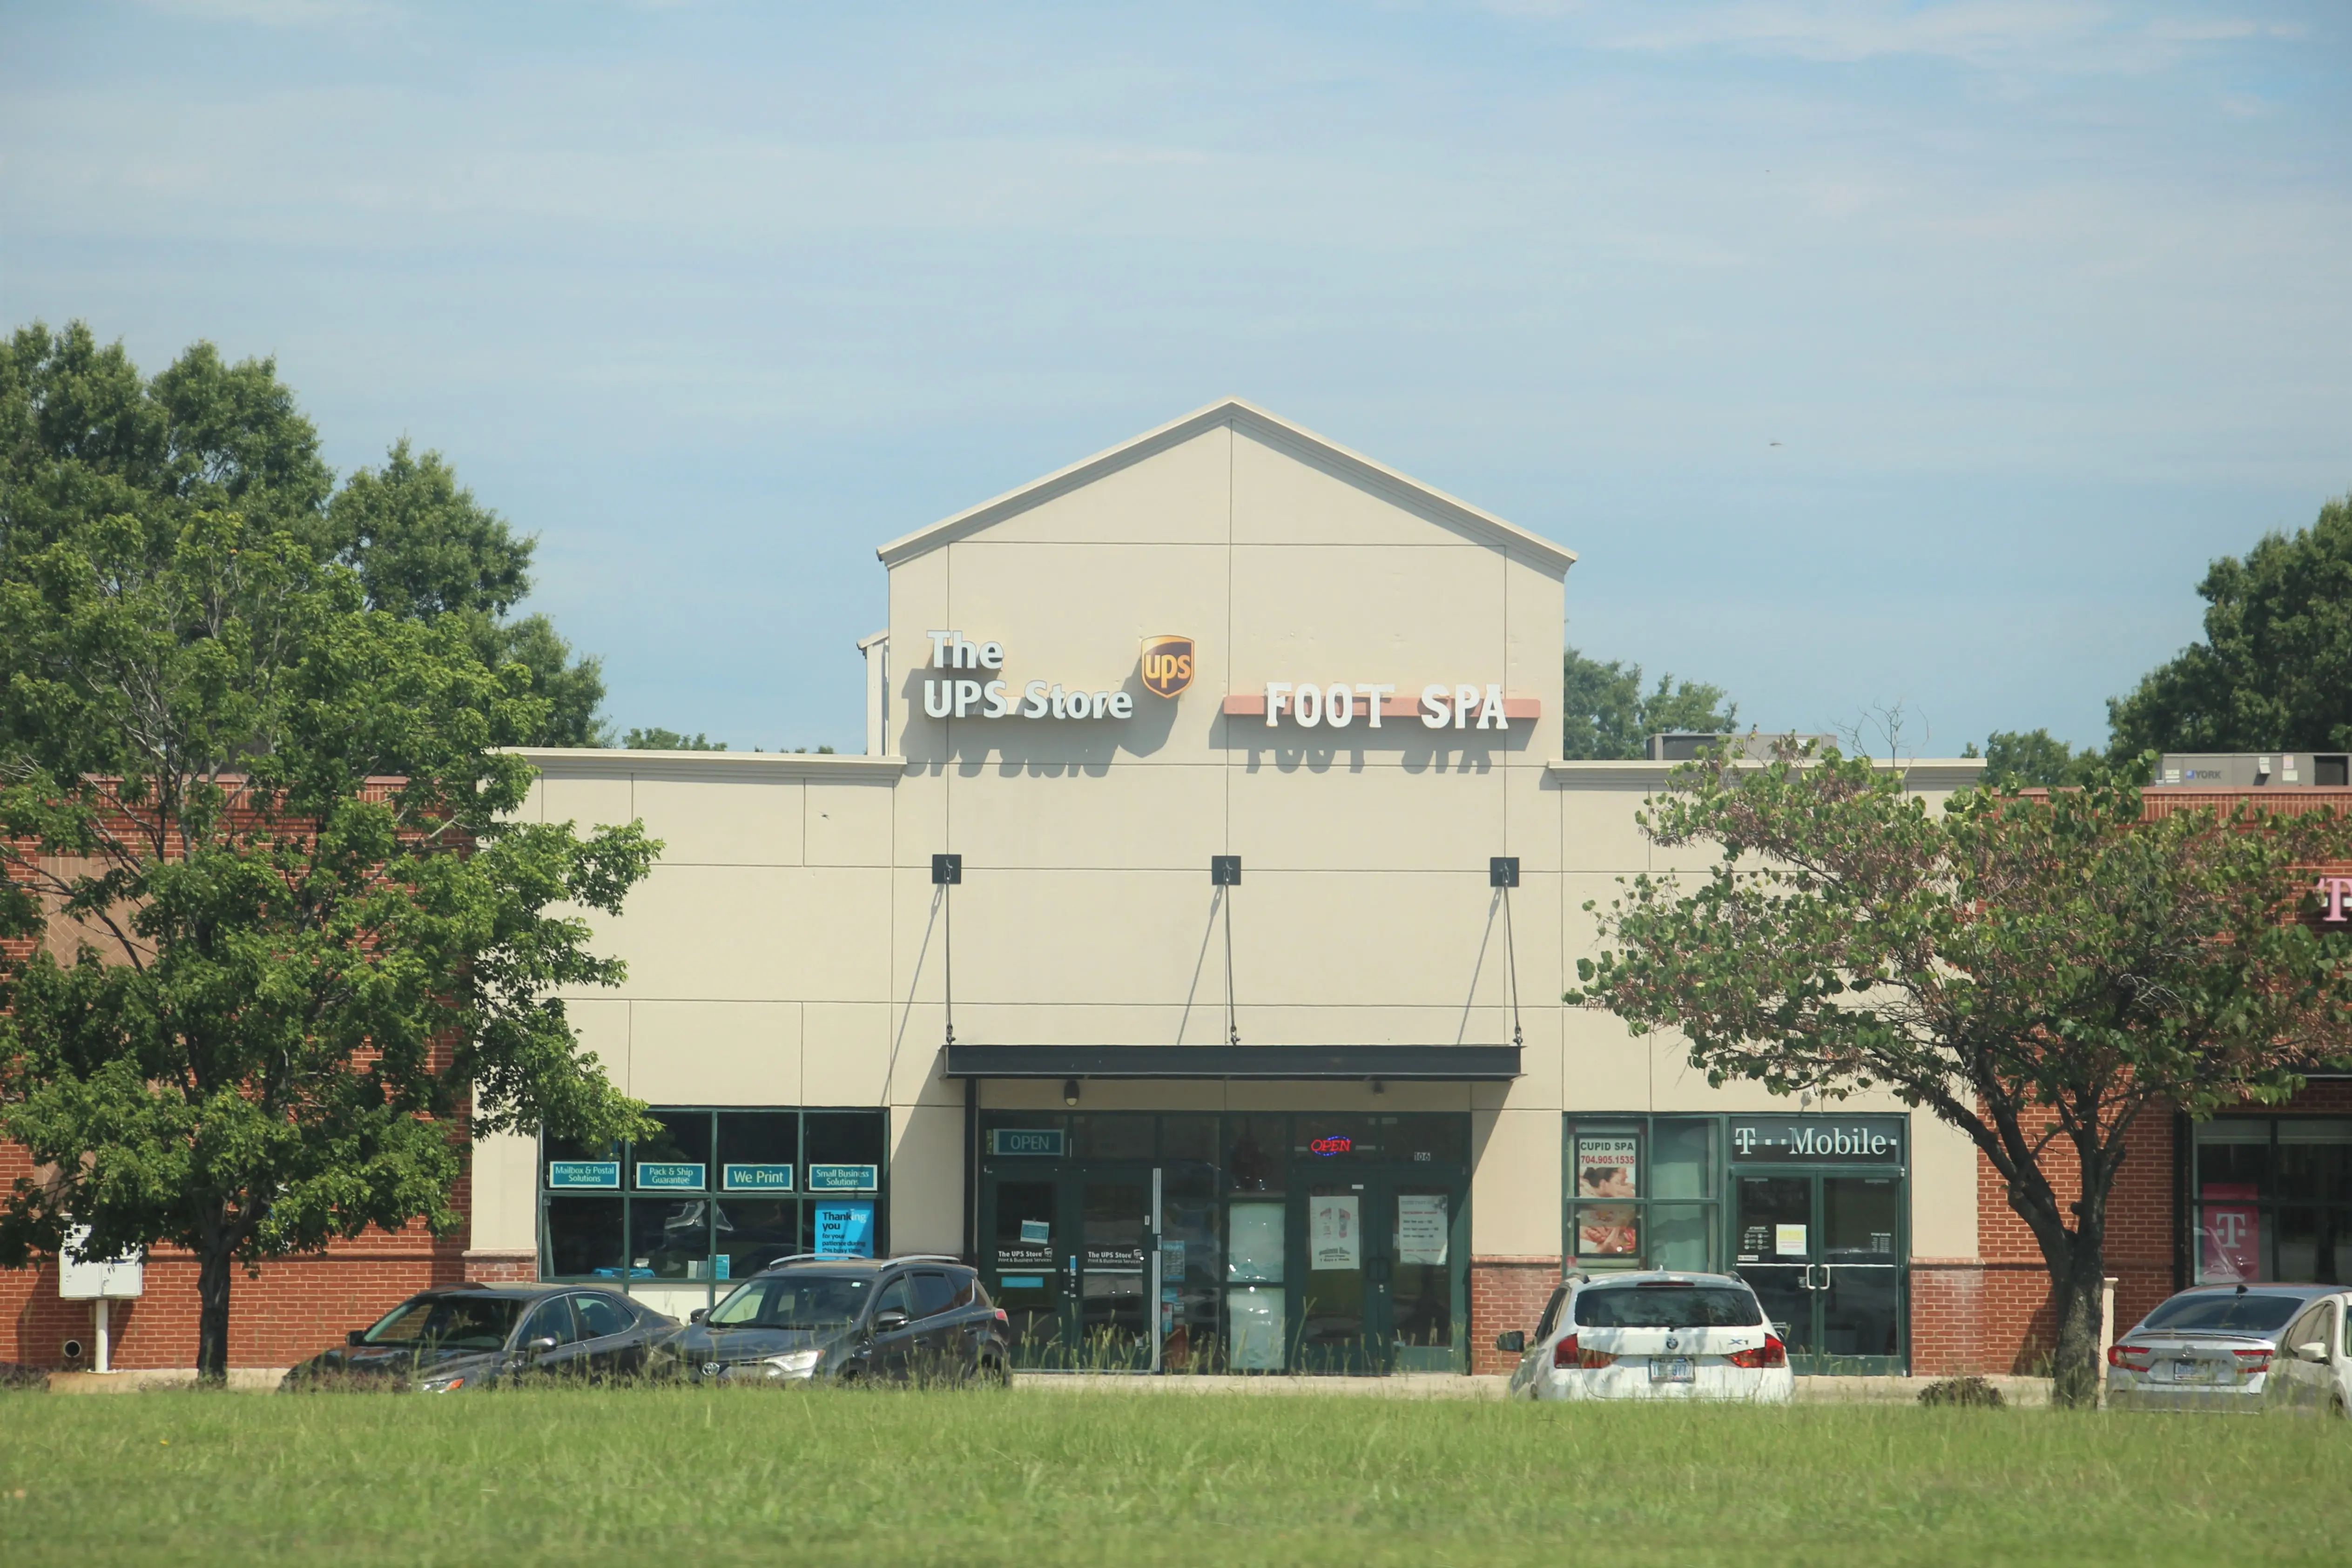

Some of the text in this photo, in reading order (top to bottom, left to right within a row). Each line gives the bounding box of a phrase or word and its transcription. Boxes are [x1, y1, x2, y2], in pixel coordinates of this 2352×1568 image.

[926, 630, 1004, 669] The
[1145, 654, 1191, 688] ups
[924, 680, 1133, 719] UPS Store
[1266, 681, 1509, 729] FOOT SPA
[1011, 1135, 1049, 1150] OPEN
[1311, 1139, 1351, 1151] OPEN
[1580, 1142, 1634, 1151] CUPID SPA
[1415, 1152, 1430, 1161] 106
[1581, 1155, 1634, 1164] 704.905.1535
[677, 1167, 693, 1177] Ship
[734, 1170, 784, 1183] We Print
[822, 1223, 840, 1232] you
